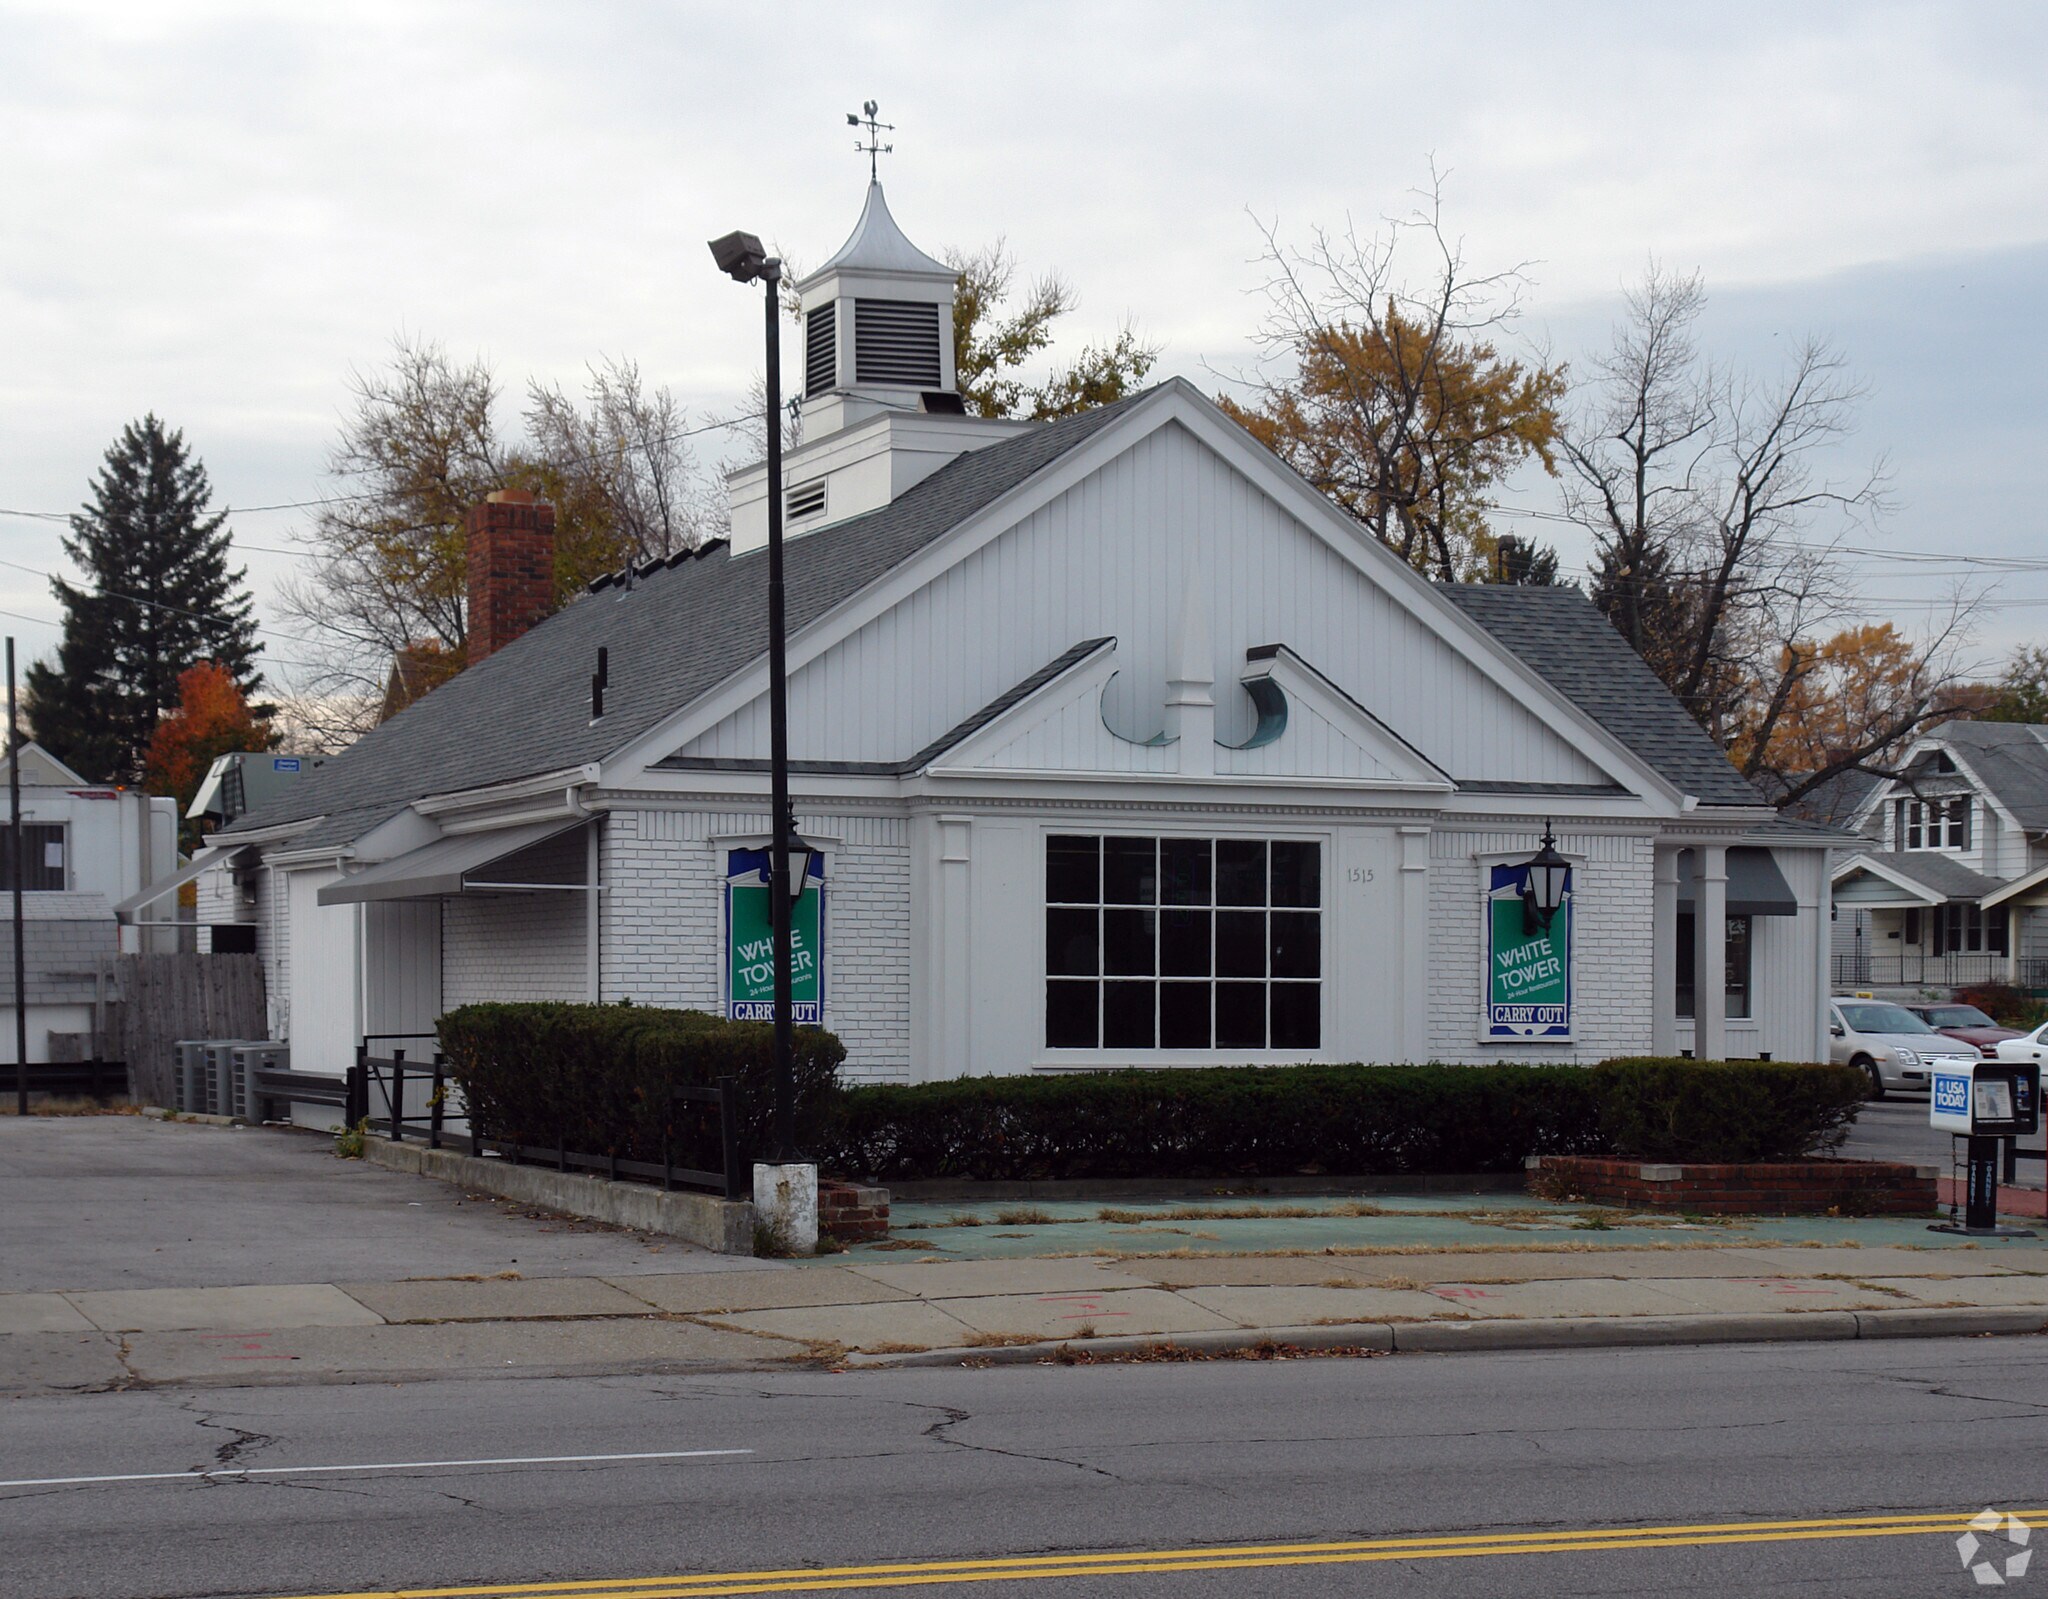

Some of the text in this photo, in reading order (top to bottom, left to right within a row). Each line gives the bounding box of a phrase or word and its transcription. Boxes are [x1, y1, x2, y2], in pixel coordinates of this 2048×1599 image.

[1348, 867, 1374, 884] 1515
[737, 929, 803, 962] WHE
[1496, 937, 1552, 968] WHITE
[1497, 957, 1561, 990] TOWER
[1495, 1007, 1563, 1022] CARRY OUT
[1946, 1080, 1966, 1095] USA
[1937, 1092, 1966, 1108] TODAY
